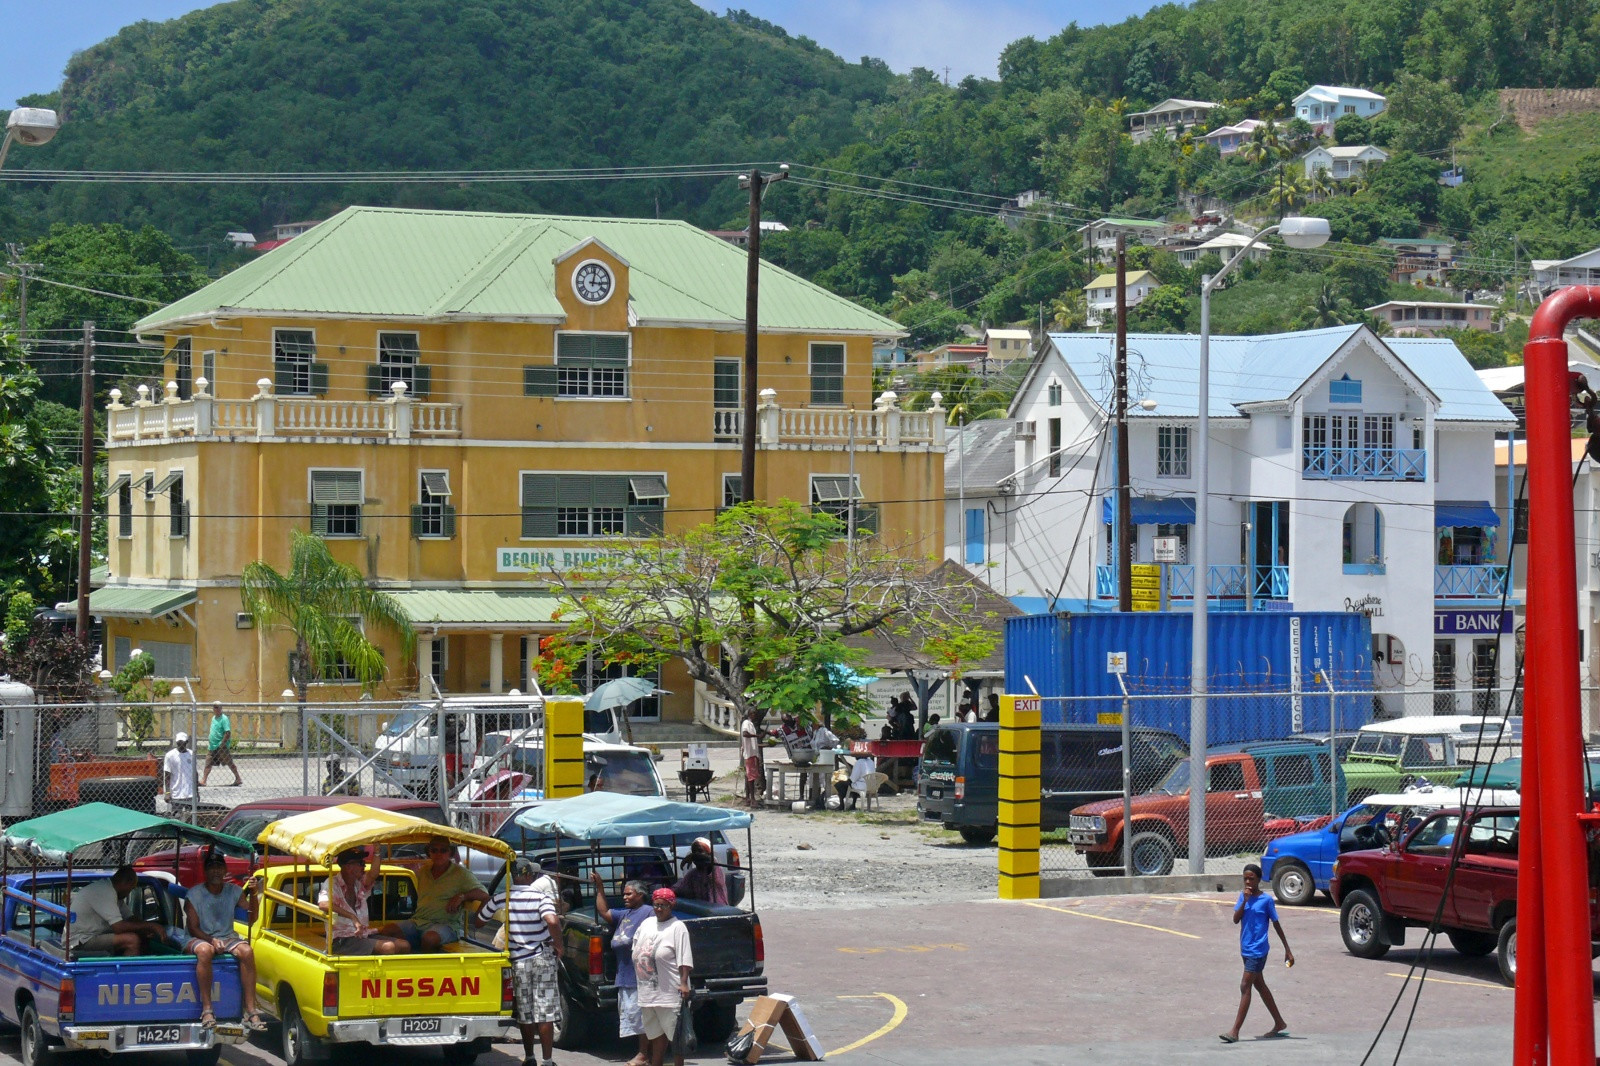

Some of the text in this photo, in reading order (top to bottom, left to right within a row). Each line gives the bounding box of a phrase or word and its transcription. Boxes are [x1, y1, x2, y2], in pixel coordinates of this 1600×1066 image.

[1456, 614, 1501, 630] BANK
[1014, 699, 1040, 711] EXIT
[97, 981, 221, 1006] NISSAN
[361, 976, 480, 999] NISSAN
[403, 1020, 440, 1032] H2057
[137, 1028, 181, 1043] HA243
